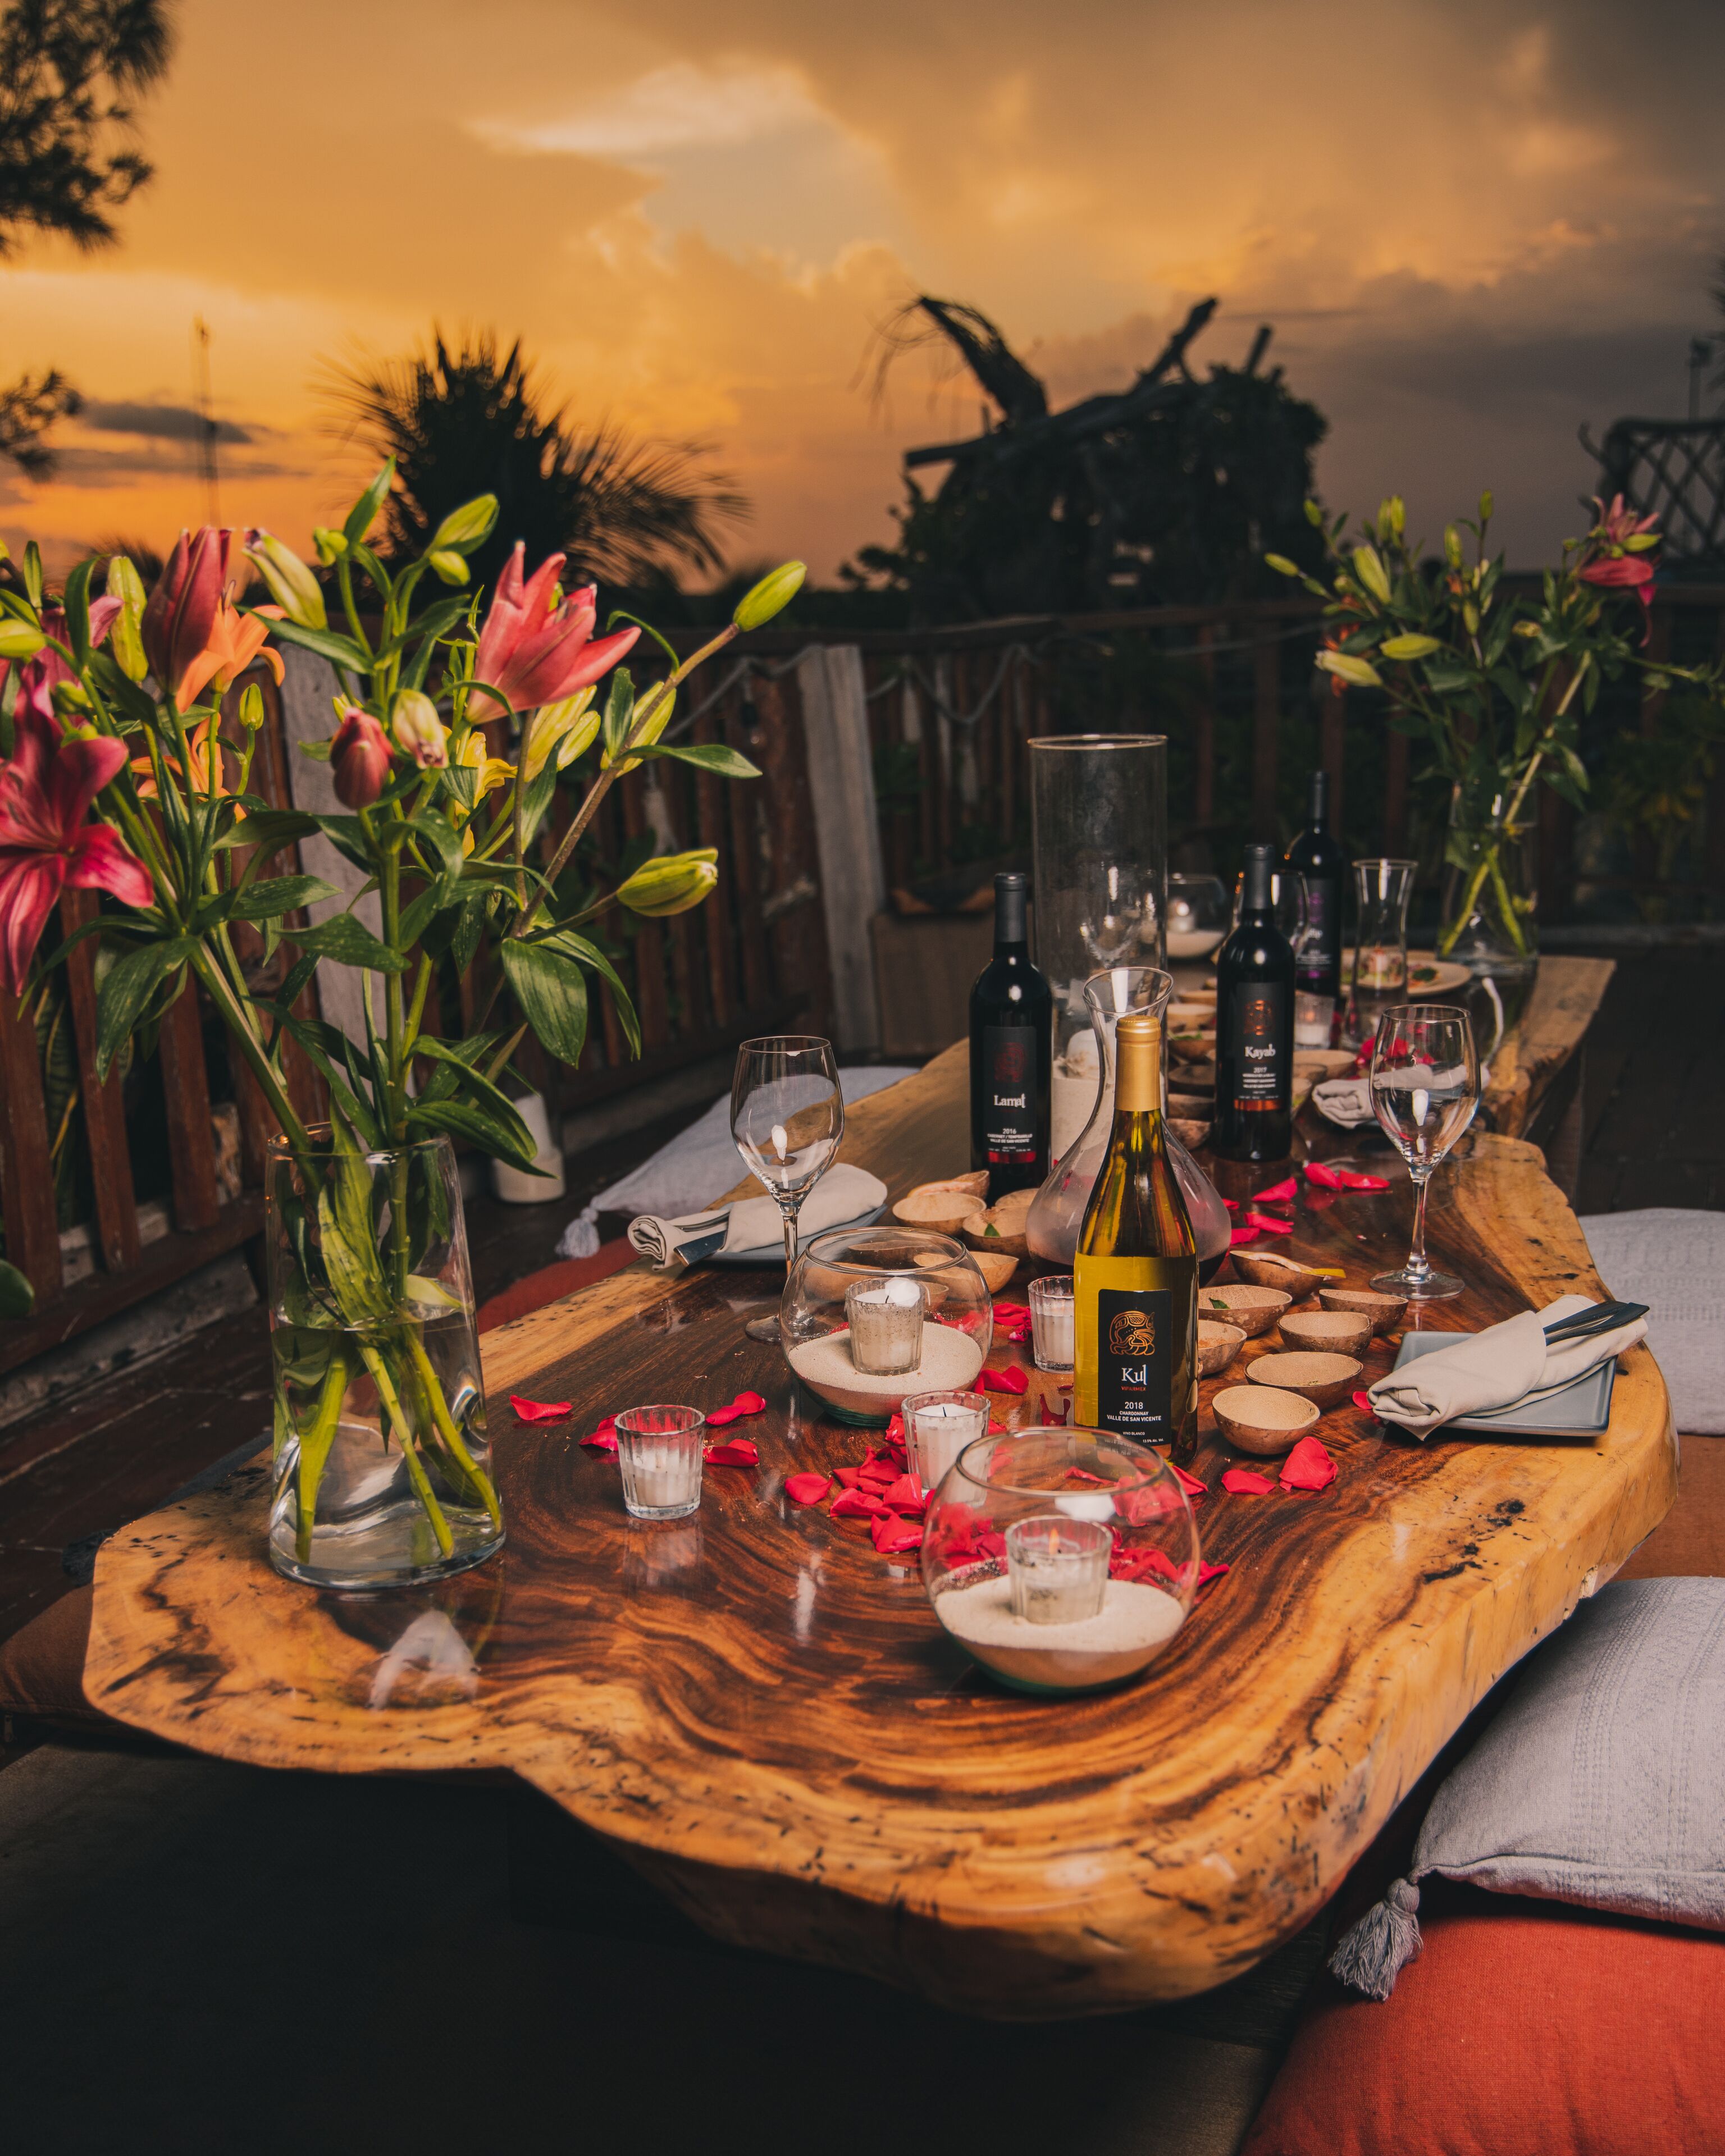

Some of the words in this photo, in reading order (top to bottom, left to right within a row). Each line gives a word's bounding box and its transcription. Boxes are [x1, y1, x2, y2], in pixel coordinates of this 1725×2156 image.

[1244, 1043, 1276, 1059] Kayab
[993, 1093, 1026, 1108] Lamat
[1121, 1364, 1147, 1385] Kul
